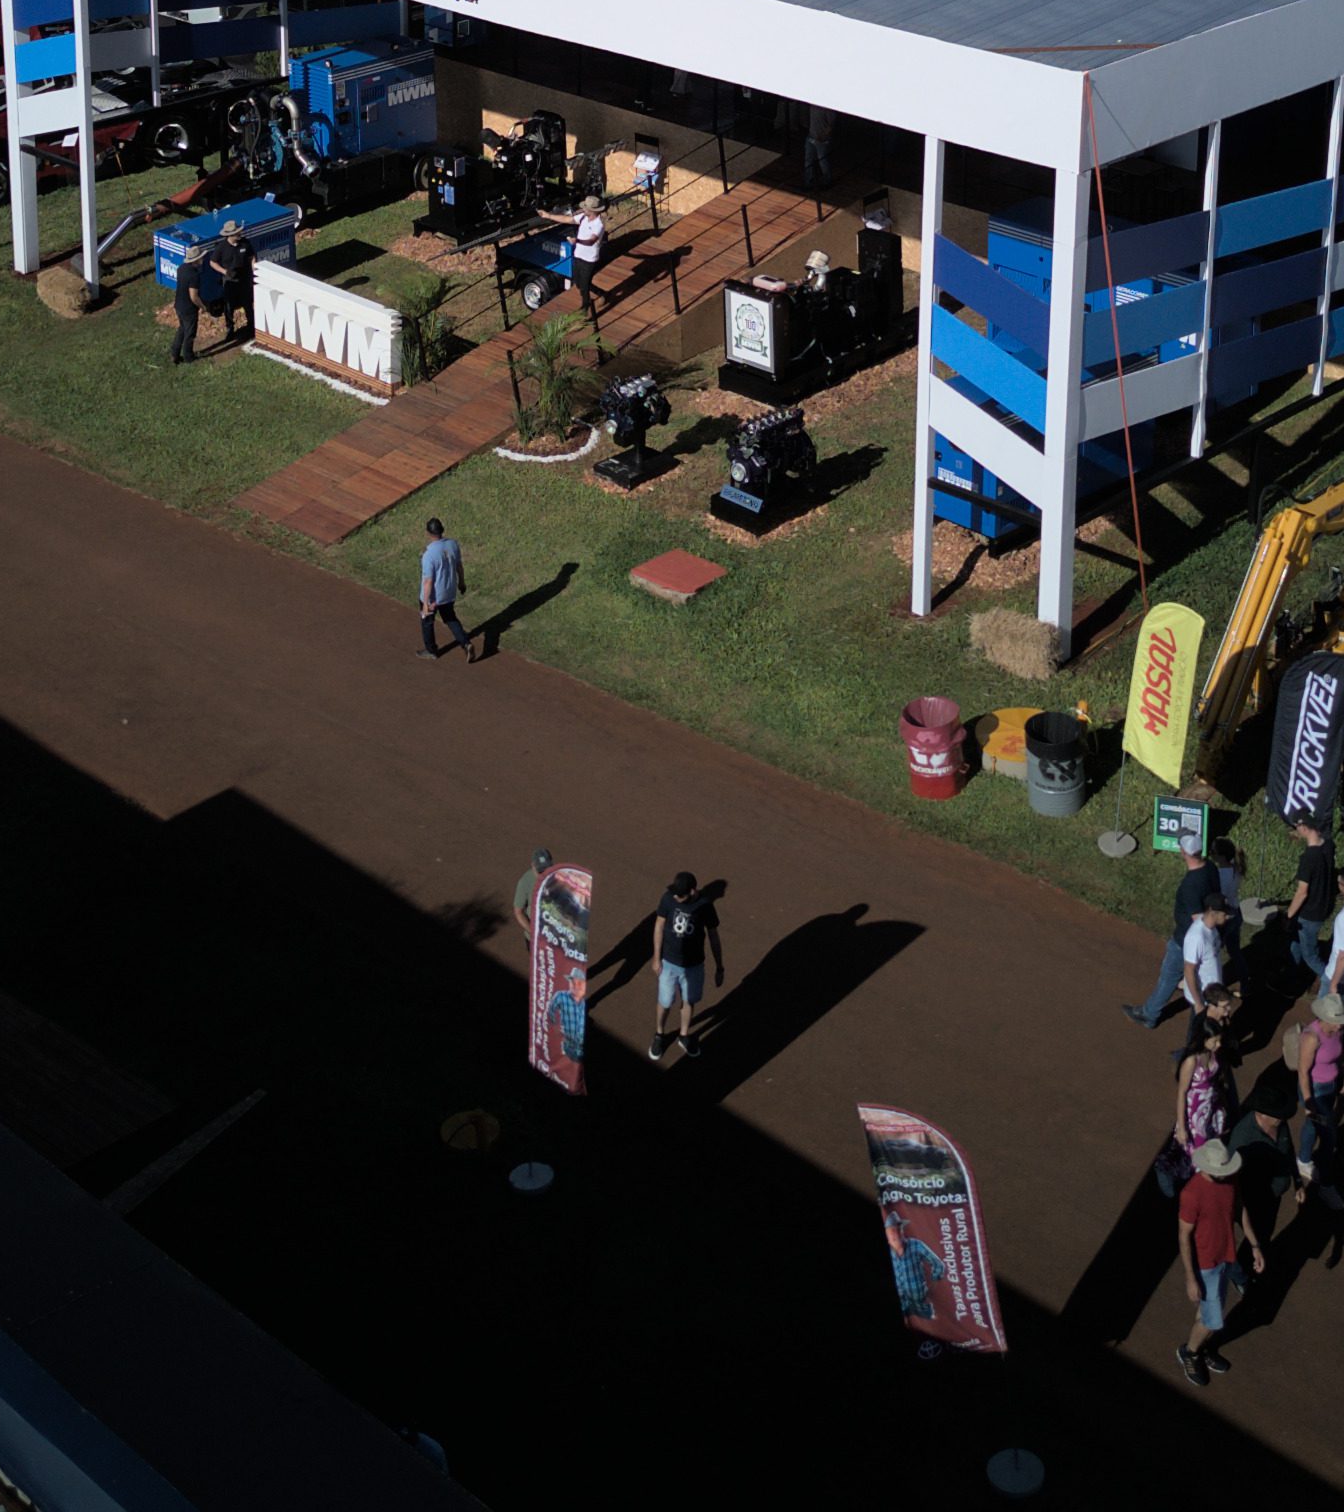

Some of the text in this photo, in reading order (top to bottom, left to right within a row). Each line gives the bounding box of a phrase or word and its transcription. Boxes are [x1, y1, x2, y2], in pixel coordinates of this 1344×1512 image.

[387, 80, 435, 107] MWM
[255, 288, 398, 379] MWM
[1143, 626, 1179, 737] MASAL
[1284, 670, 1340, 816] TRUCKVEL
[1158, 818, 1179, 832] 30
[877, 1173, 945, 1189] Consórcio
[881, 1190, 967, 1207] Agro Toyota:
[939, 1217, 968, 1321] Taxas Exclusivas
[951, 1207, 989, 1328] para Produtor Rural
